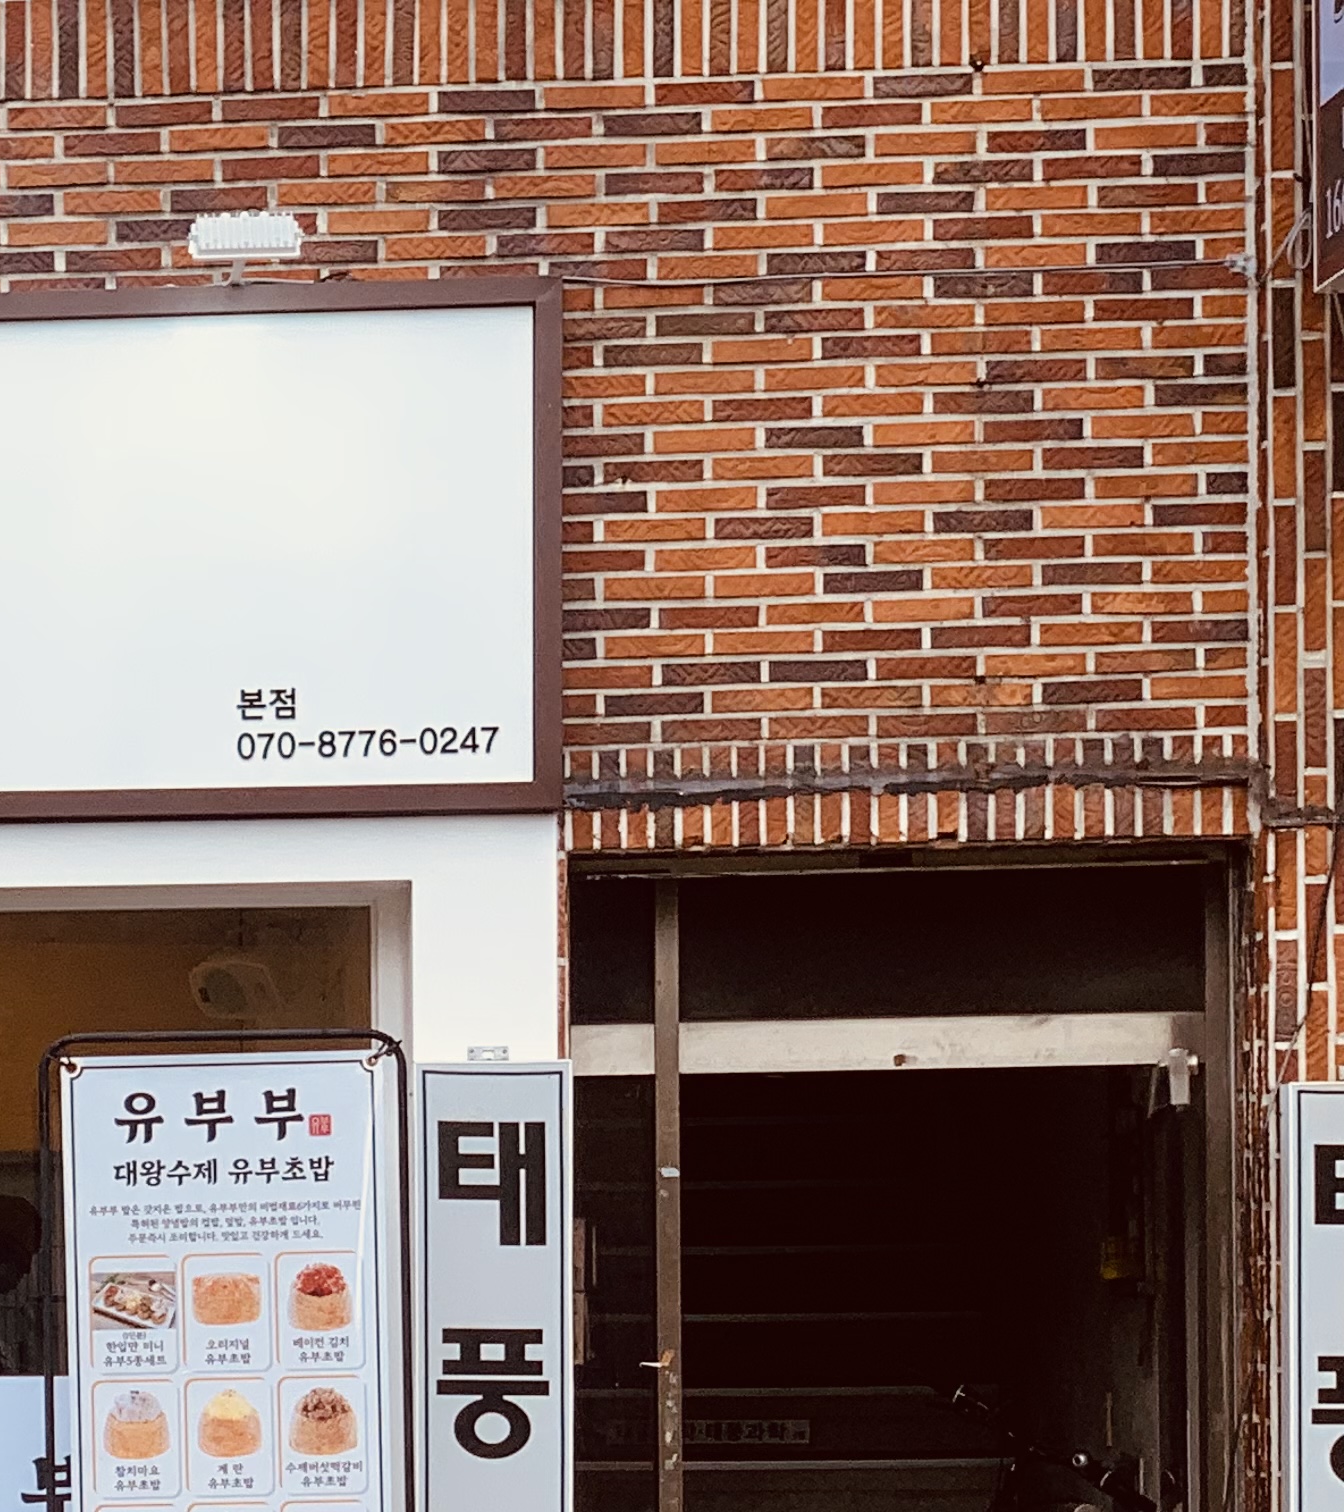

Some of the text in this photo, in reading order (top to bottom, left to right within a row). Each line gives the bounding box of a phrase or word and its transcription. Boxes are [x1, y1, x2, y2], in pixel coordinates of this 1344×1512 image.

[237, 687, 297, 721] 본점
[237, 726, 500, 760] 070-8776-0247
[114, 1087, 304, 1144] 유부부
[114, 1155, 334, 1187] 대왕수제 유부초밥
[206, 1338, 249, 1350] 오리지널
[329, 1336, 349, 1349] 김치
[205, 1353, 251, 1365] 유부초밥
[299, 1351, 344, 1363] 유부초밥
[115, 1465, 160, 1477] 참치마요
[114, 1479, 160, 1491] 유부초밥
[208, 1477, 254, 1489] 유부초밥
[301, 1475, 348, 1487] 유부초밥
